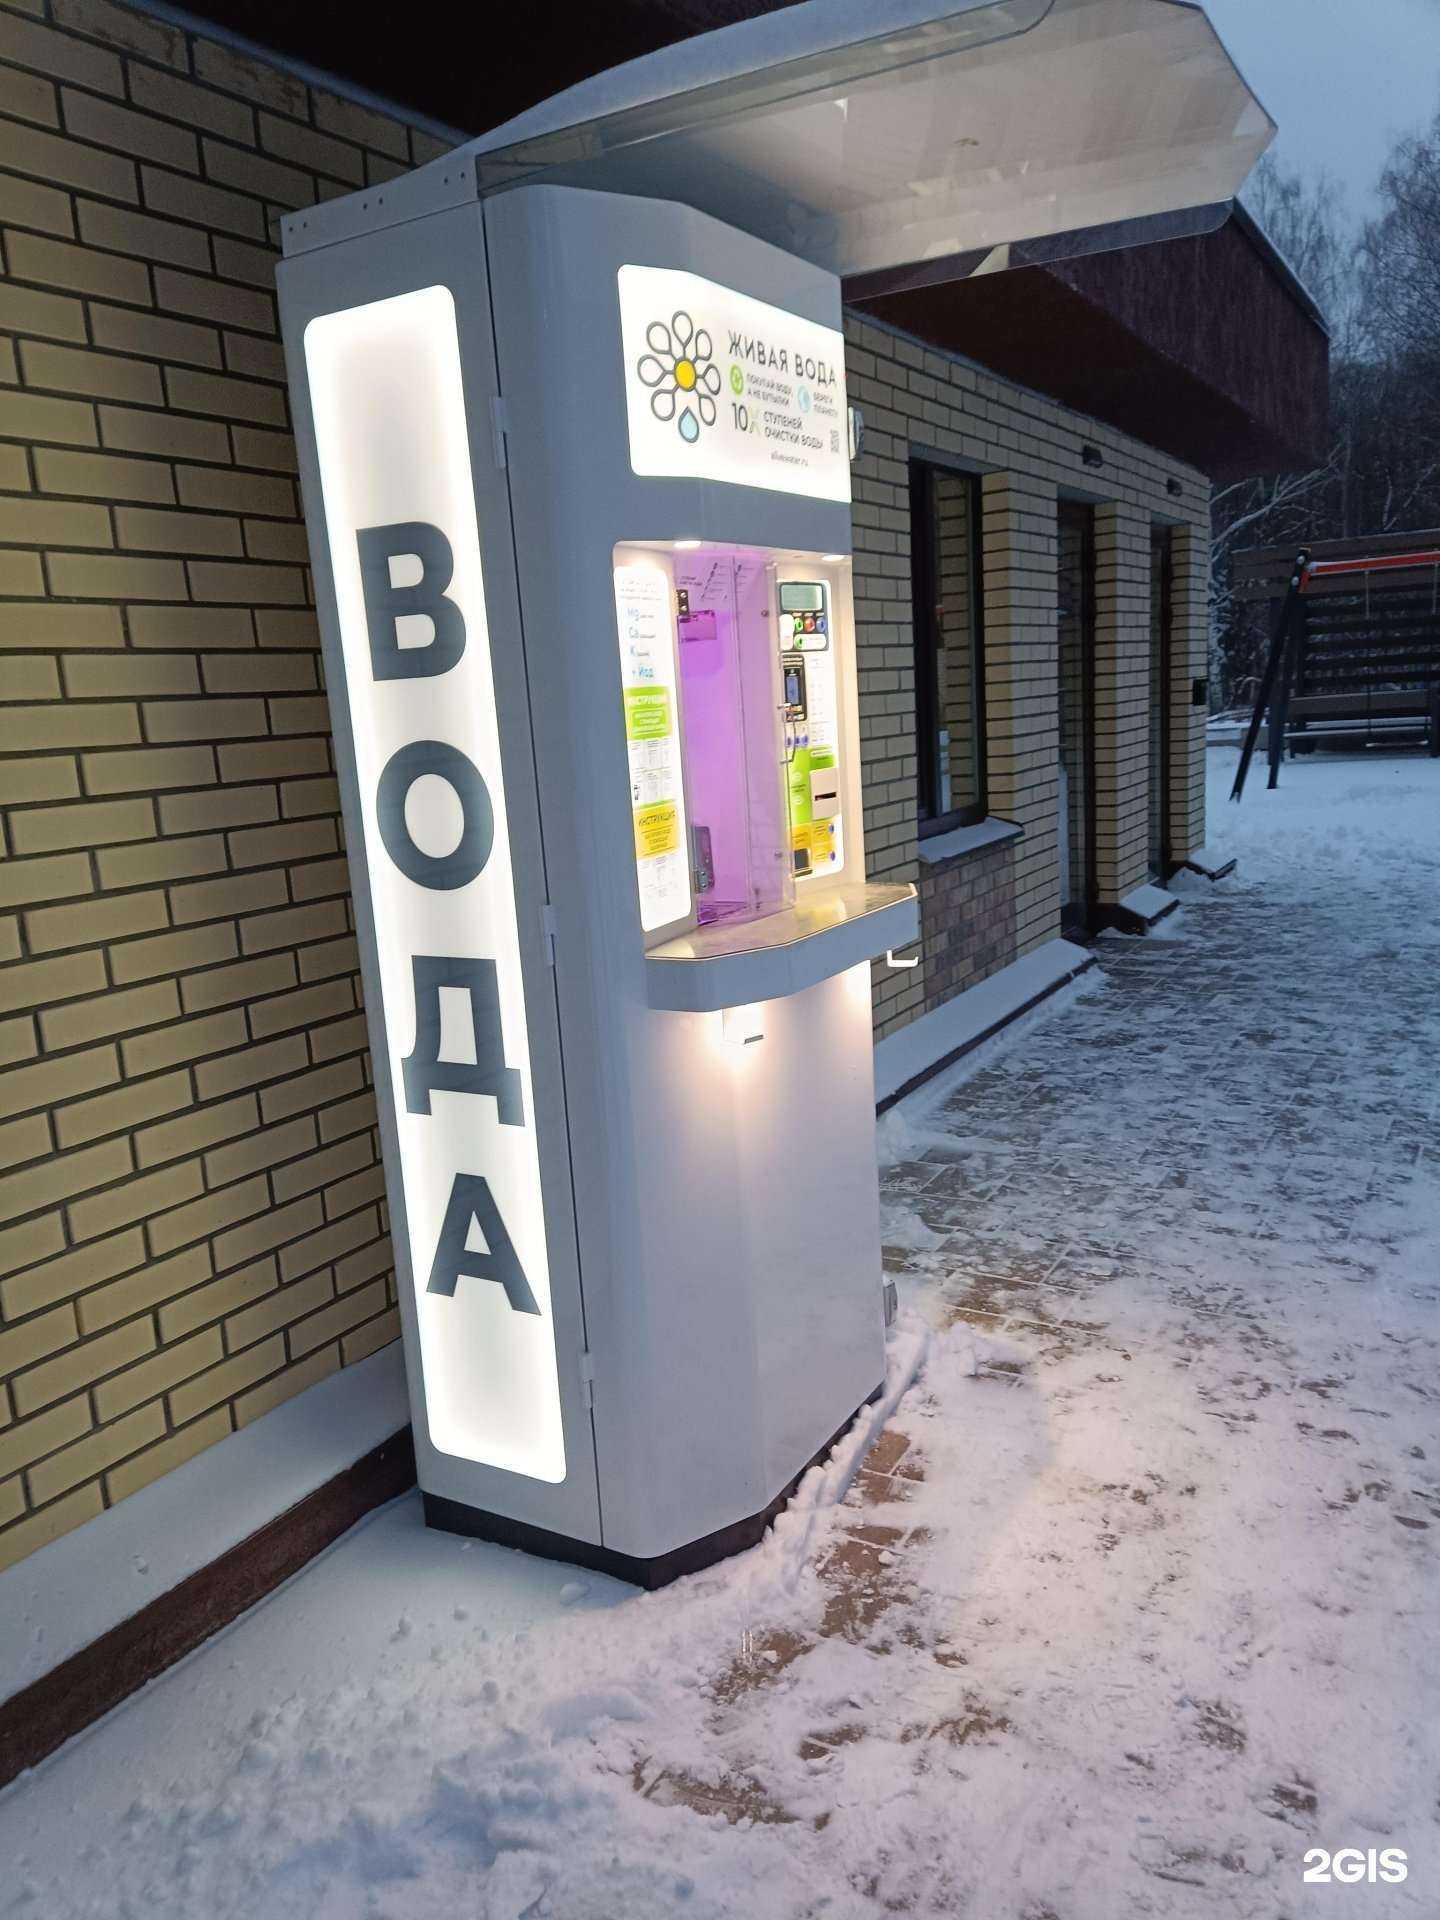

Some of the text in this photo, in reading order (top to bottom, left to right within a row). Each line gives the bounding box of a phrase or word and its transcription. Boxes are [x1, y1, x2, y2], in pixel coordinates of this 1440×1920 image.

[728, 329, 836, 388] ЖИВАЯ ВОДА
[763, 410, 802, 431] СТУПЕНЕЙ
[764, 426, 824, 449] ОЧИСТКИ ВОДЫ
[355, 520, 543, 1316] ВОДА
